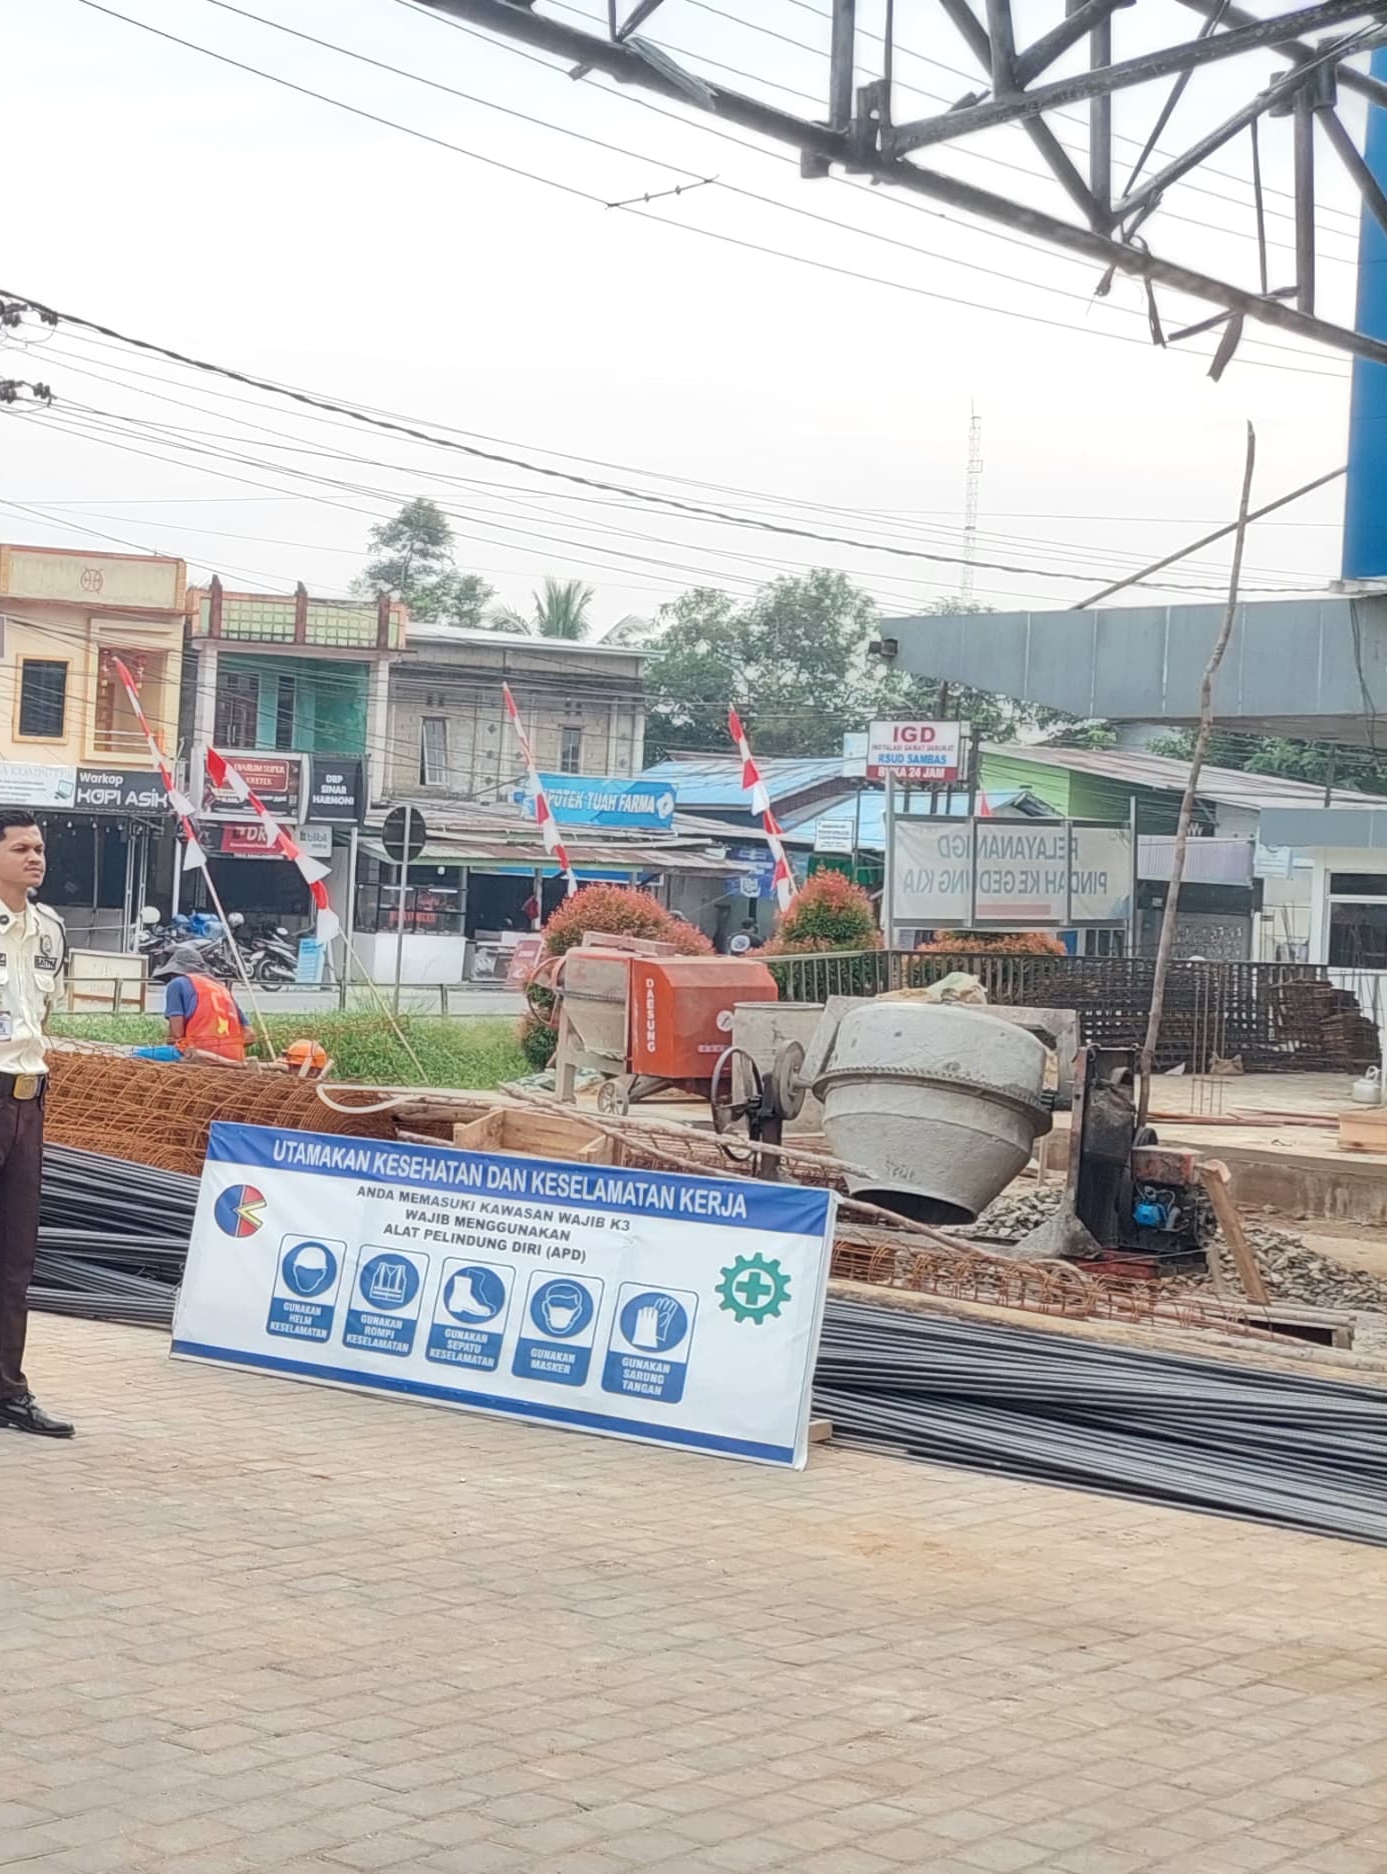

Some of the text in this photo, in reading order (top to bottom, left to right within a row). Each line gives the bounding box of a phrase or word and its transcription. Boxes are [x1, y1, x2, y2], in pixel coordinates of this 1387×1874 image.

[893, 726, 936, 743] IGD
[878, 754, 947, 764] RSUD SAMBAS
[80, 772, 123, 786] Warkop
[878, 767, 945, 778] BKA 24 JAM
[78, 788, 168, 808] KOPI ASIK
[588, 792, 617, 811] TUAH
[618, 794, 655, 813] FARMA
[645, 977, 656, 1053] DAESUNG
[273, 1139, 747, 1219] UTAMAKAN KESEHATAN DAN KESELAMATAN KERJA
[357, 1186, 630, 1231] ANDA MEMASUKI KAWASAN WAJIB K3
[405, 1209, 570, 1242] WAJIB MENGGUNAKAN
[383, 1224, 586, 1264] ALAT PELINDUNG DIRI (APD)
[283, 1301, 321, 1316] GUNAKAN
[289, 1313, 312, 1326] HELM
[360, 1314, 403, 1330] GUNAKAN
[270, 1321, 327, 1339] KESELAMATAN
[364, 1326, 395, 1339] ROMPI
[444, 1328, 488, 1344] GUNAKAN
[346, 1335, 409, 1353] KESELAMATAN
[446, 1340, 482, 1355] SEPATU
[429, 1348, 495, 1367] KESELAMATAN
[530, 1347, 575, 1364] GUNAKAN
[530, 1359, 571, 1375] MASKER
[621, 1356, 671, 1374] GUNAKAN
[623, 1368, 665, 1385] SARUNG
[622, 1379, 662, 1396] TANGAN
